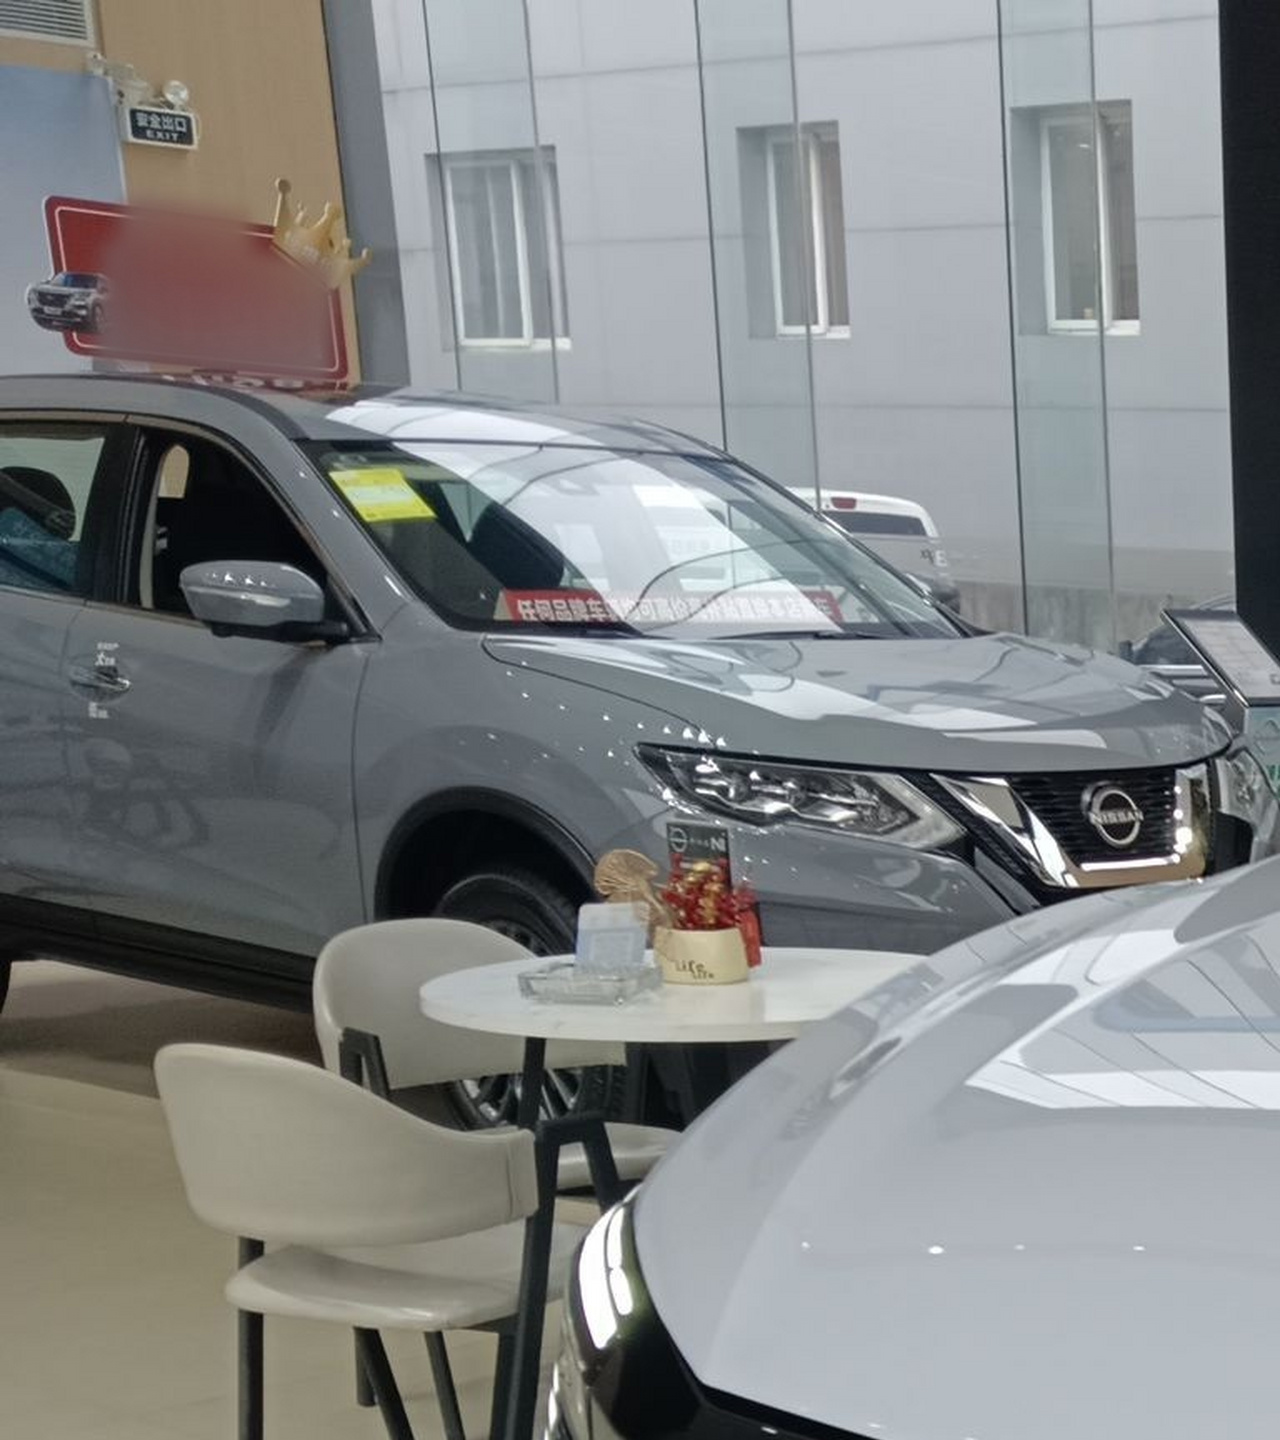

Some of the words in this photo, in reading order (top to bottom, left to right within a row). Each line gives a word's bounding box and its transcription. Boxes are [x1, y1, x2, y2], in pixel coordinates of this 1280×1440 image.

[135, 111, 188, 133] 安全出口
[146, 129, 179, 141] EXIT
[1088, 809, 1145, 826] NISSAN
